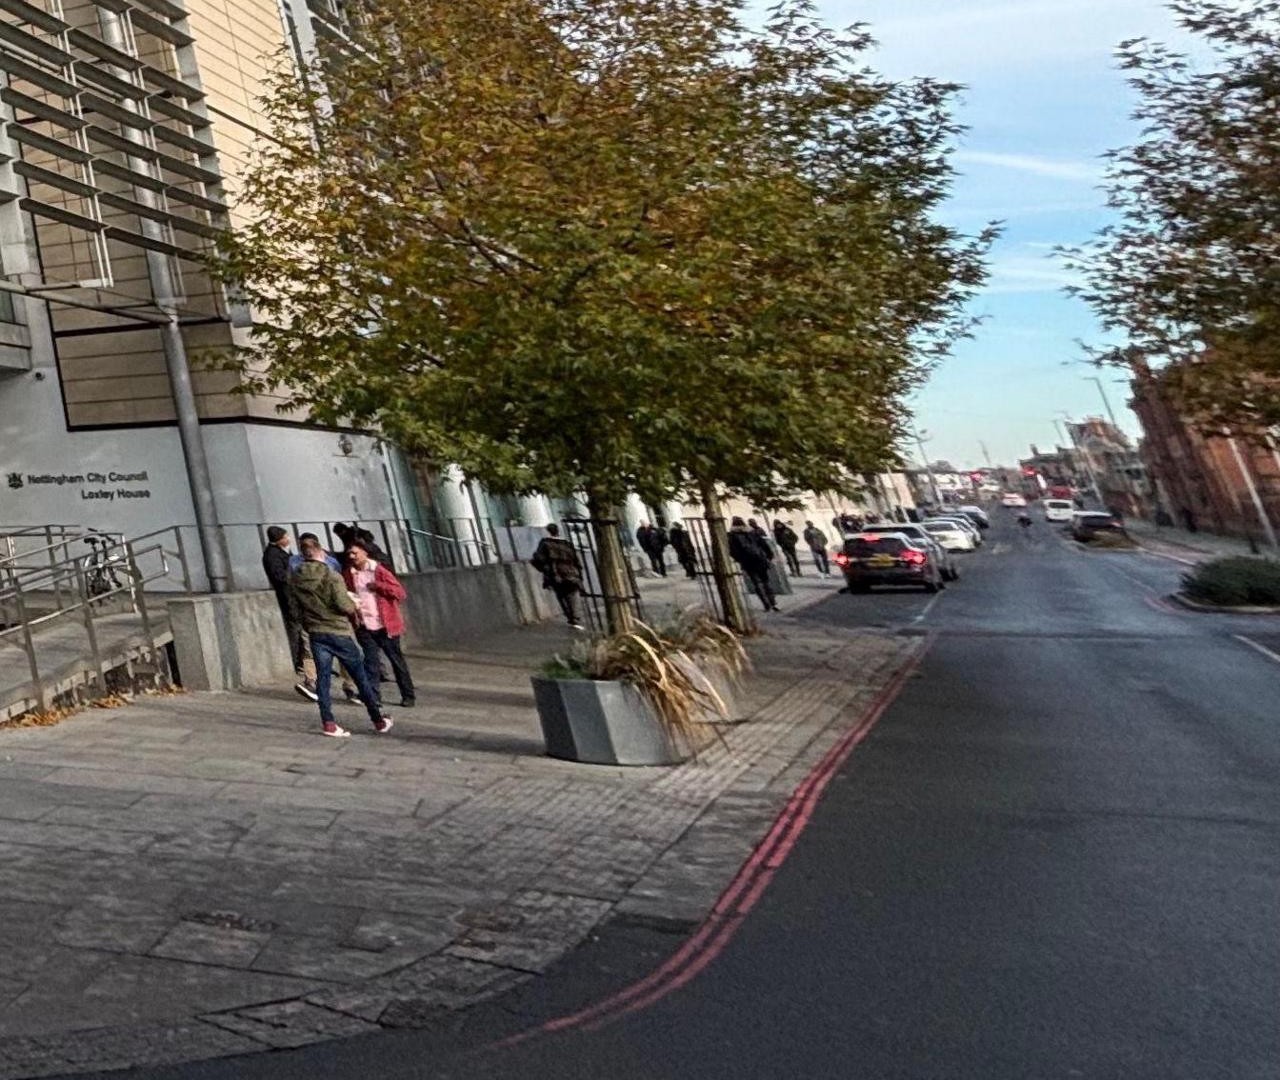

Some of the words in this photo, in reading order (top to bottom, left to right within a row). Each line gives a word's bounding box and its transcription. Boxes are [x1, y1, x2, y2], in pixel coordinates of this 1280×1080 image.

[27, 474, 84, 486] Nottingham
[87, 472, 106, 484] City
[108, 471, 149, 482] Council
[81, 489, 115, 501] Loxley
[117, 488, 151, 498] House
